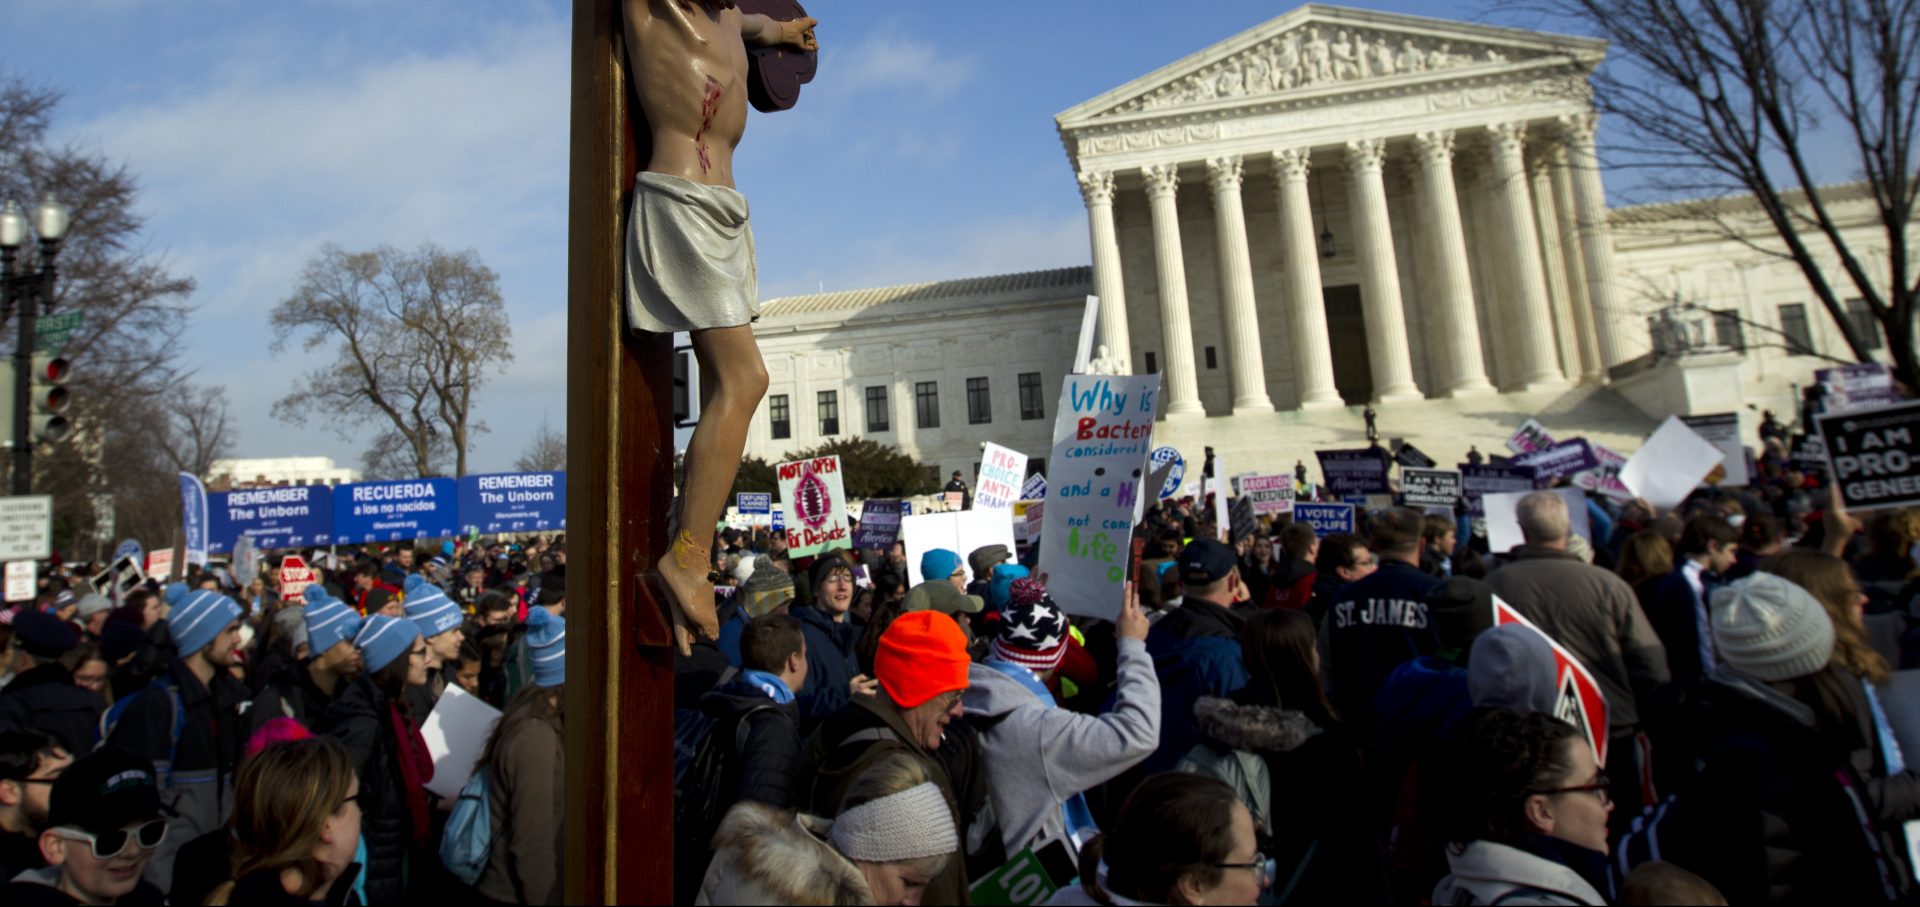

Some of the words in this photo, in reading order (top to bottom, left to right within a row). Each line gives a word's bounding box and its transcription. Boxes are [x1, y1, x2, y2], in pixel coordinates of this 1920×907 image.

[34, 316, 71, 333] FIRST
[1071, 380, 1127, 416] Why
[1140, 385, 1154, 412] is
[1836, 436, 1848, 453] I
[1861, 427, 1913, 450] AM
[1065, 442, 1137, 458] considered
[778, 462, 803, 480] NOT
[812, 457, 838, 474] OPEN
[991, 450, 1019, 470] PRO-
[478, 474, 554, 490] REMEMBER
[981, 480, 1014, 499] ANTI-
[1060, 480, 1091, 497] and
[1100, 487, 1111, 497] a
[1403, 484, 1458, 496] PRO-LIFE
[228, 487, 309, 506] REMEMBER
[353, 483, 436, 501] RECUERDA
[480, 492, 504, 504] The
[507, 490, 554, 502] Unborn
[975, 492, 1012, 509] SHAM
[228, 508, 255, 521] The
[258, 505, 309, 519] Unborn
[354, 506, 361, 515] a
[362, 503, 379, 515] los
[380, 503, 394, 513] no
[396, 500, 436, 512] nacidos
[1297, 508, 1302, 518] I
[1304, 507, 1336, 519] VOTE
[1068, 514, 1089, 527] not
[1312, 519, 1348, 531] O-LIFE
[803, 520, 846, 547] Debate
[1068, 527, 1118, 563] life
[283, 567, 309, 581] STOP
[1335, 600, 1358, 629] ST.
[1360, 598, 1429, 630] JAMES
